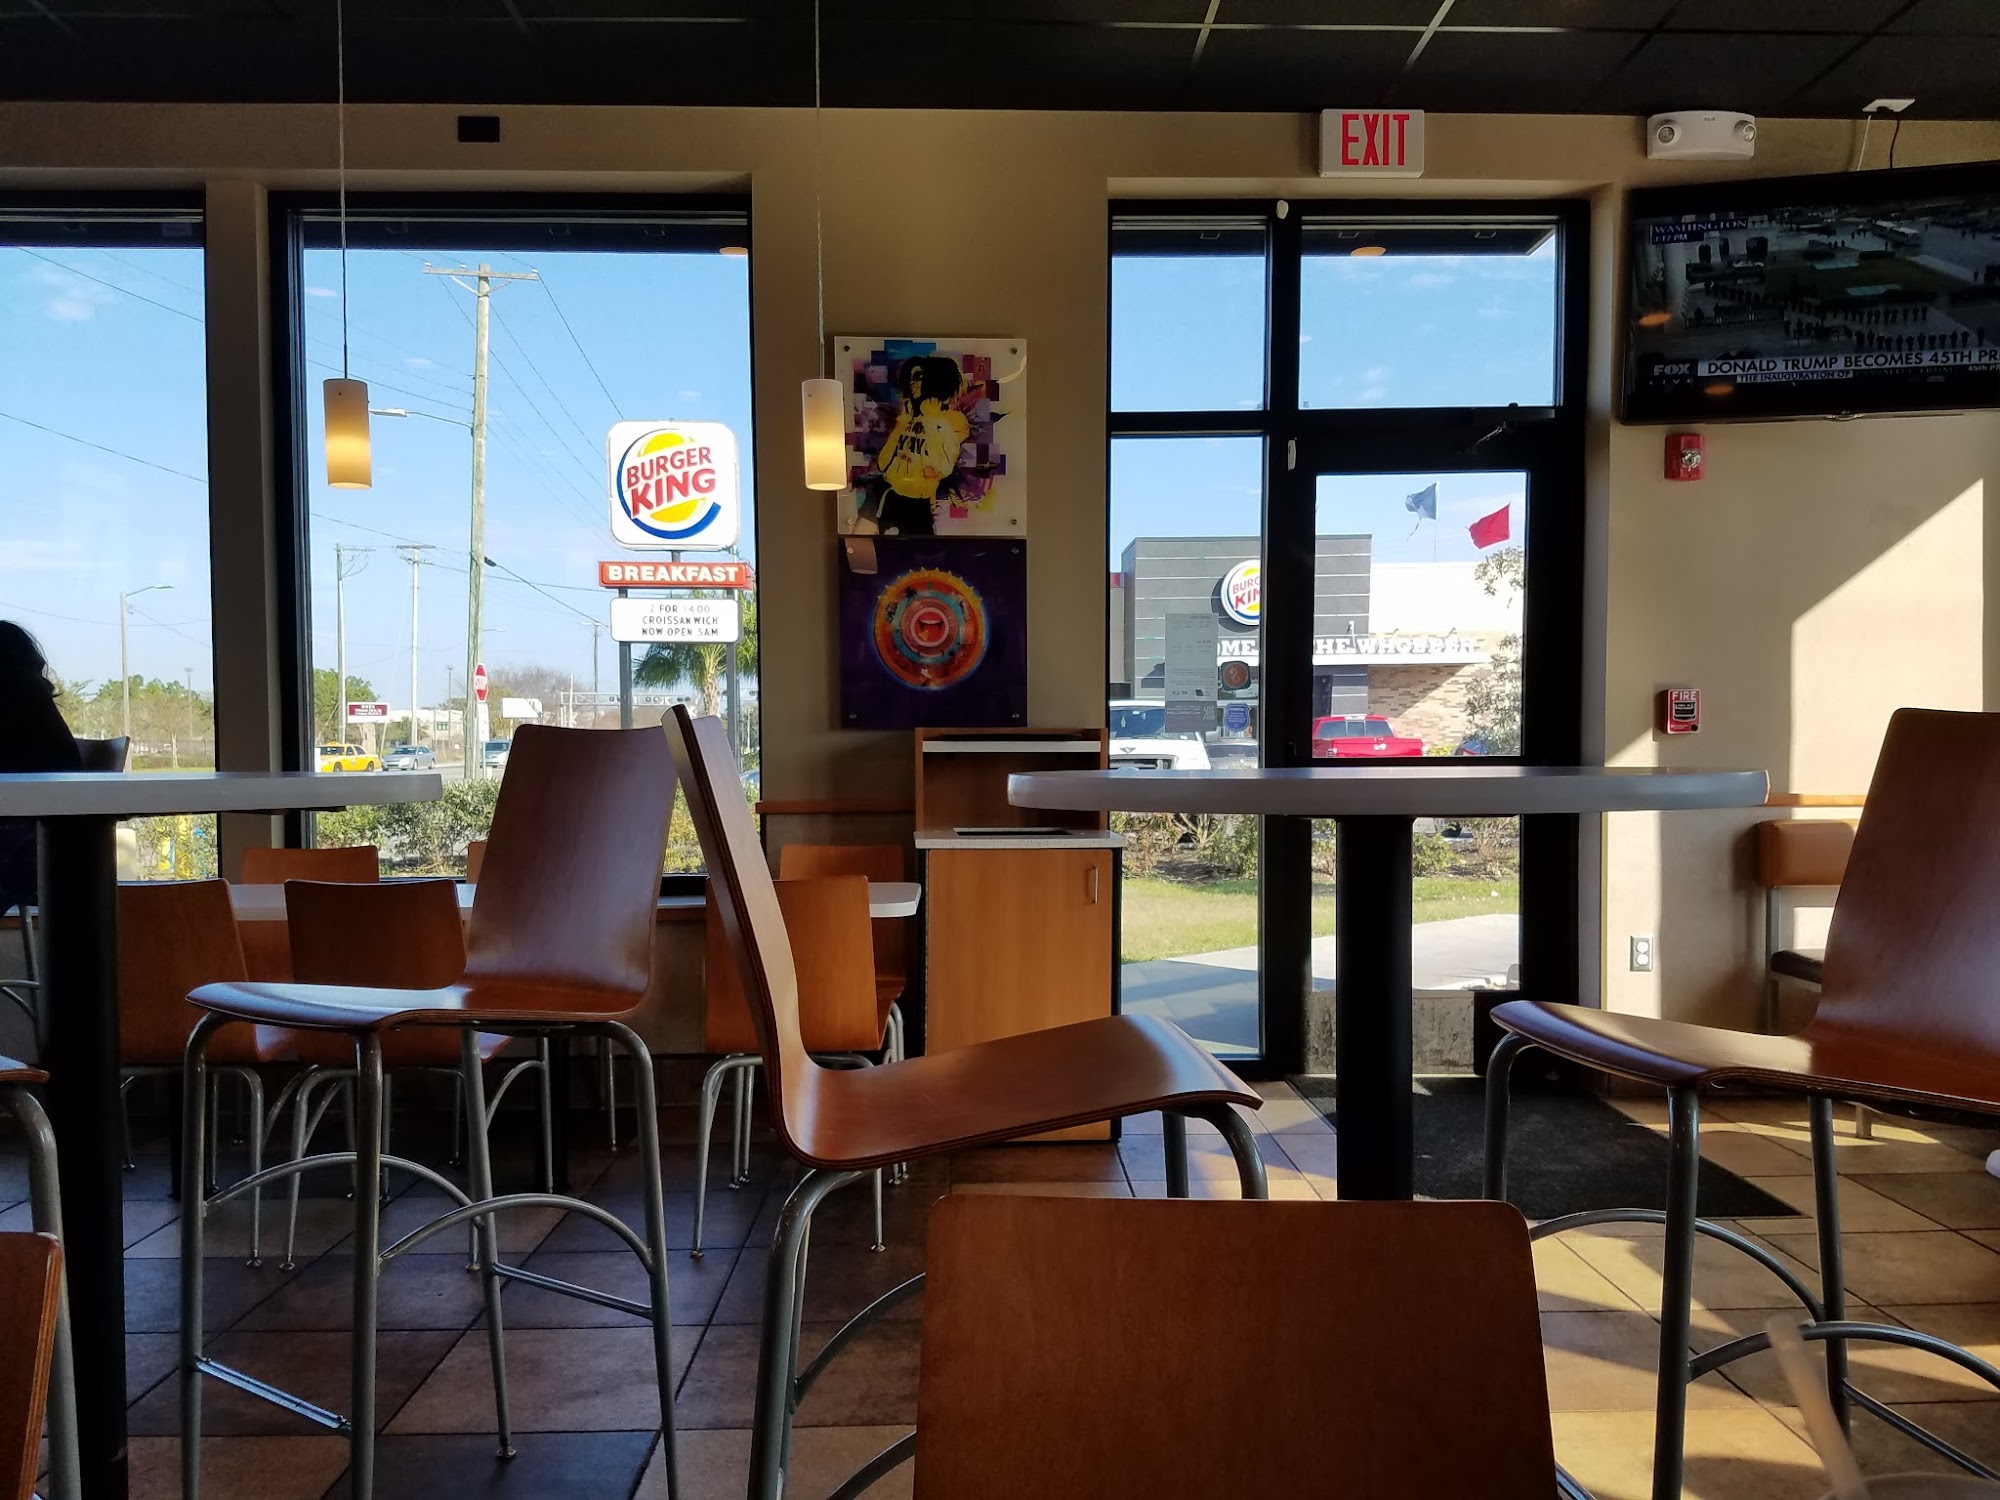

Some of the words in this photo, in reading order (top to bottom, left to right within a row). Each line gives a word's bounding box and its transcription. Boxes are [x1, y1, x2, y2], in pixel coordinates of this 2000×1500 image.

[1341, 113, 1410, 166] EXIT
[1654, 219, 1747, 233] WASHINGTON
[1653, 363, 1690, 376] FOX
[1708, 359, 1777, 374] DONALD
[1783, 355, 1838, 372] TRUMP
[1844, 353, 1923, 369] BECOMES
[1929, 351, 1972, 365] 45TH
[1977, 349, 2000, 362] PR
[1760, 370, 1835, 381] INAUGURATION
[627, 446, 712, 488] BURGER
[631, 468, 716, 517] KING
[608, 565, 738, 583] BREAKFAST
[659, 604, 678, 613] FOR
[642, 628, 663, 636] NOW
[667, 628, 693, 637] OPEN
[1356, 636, 1475, 654] WHOPPER
[1672, 691, 1697, 701] FIRE
